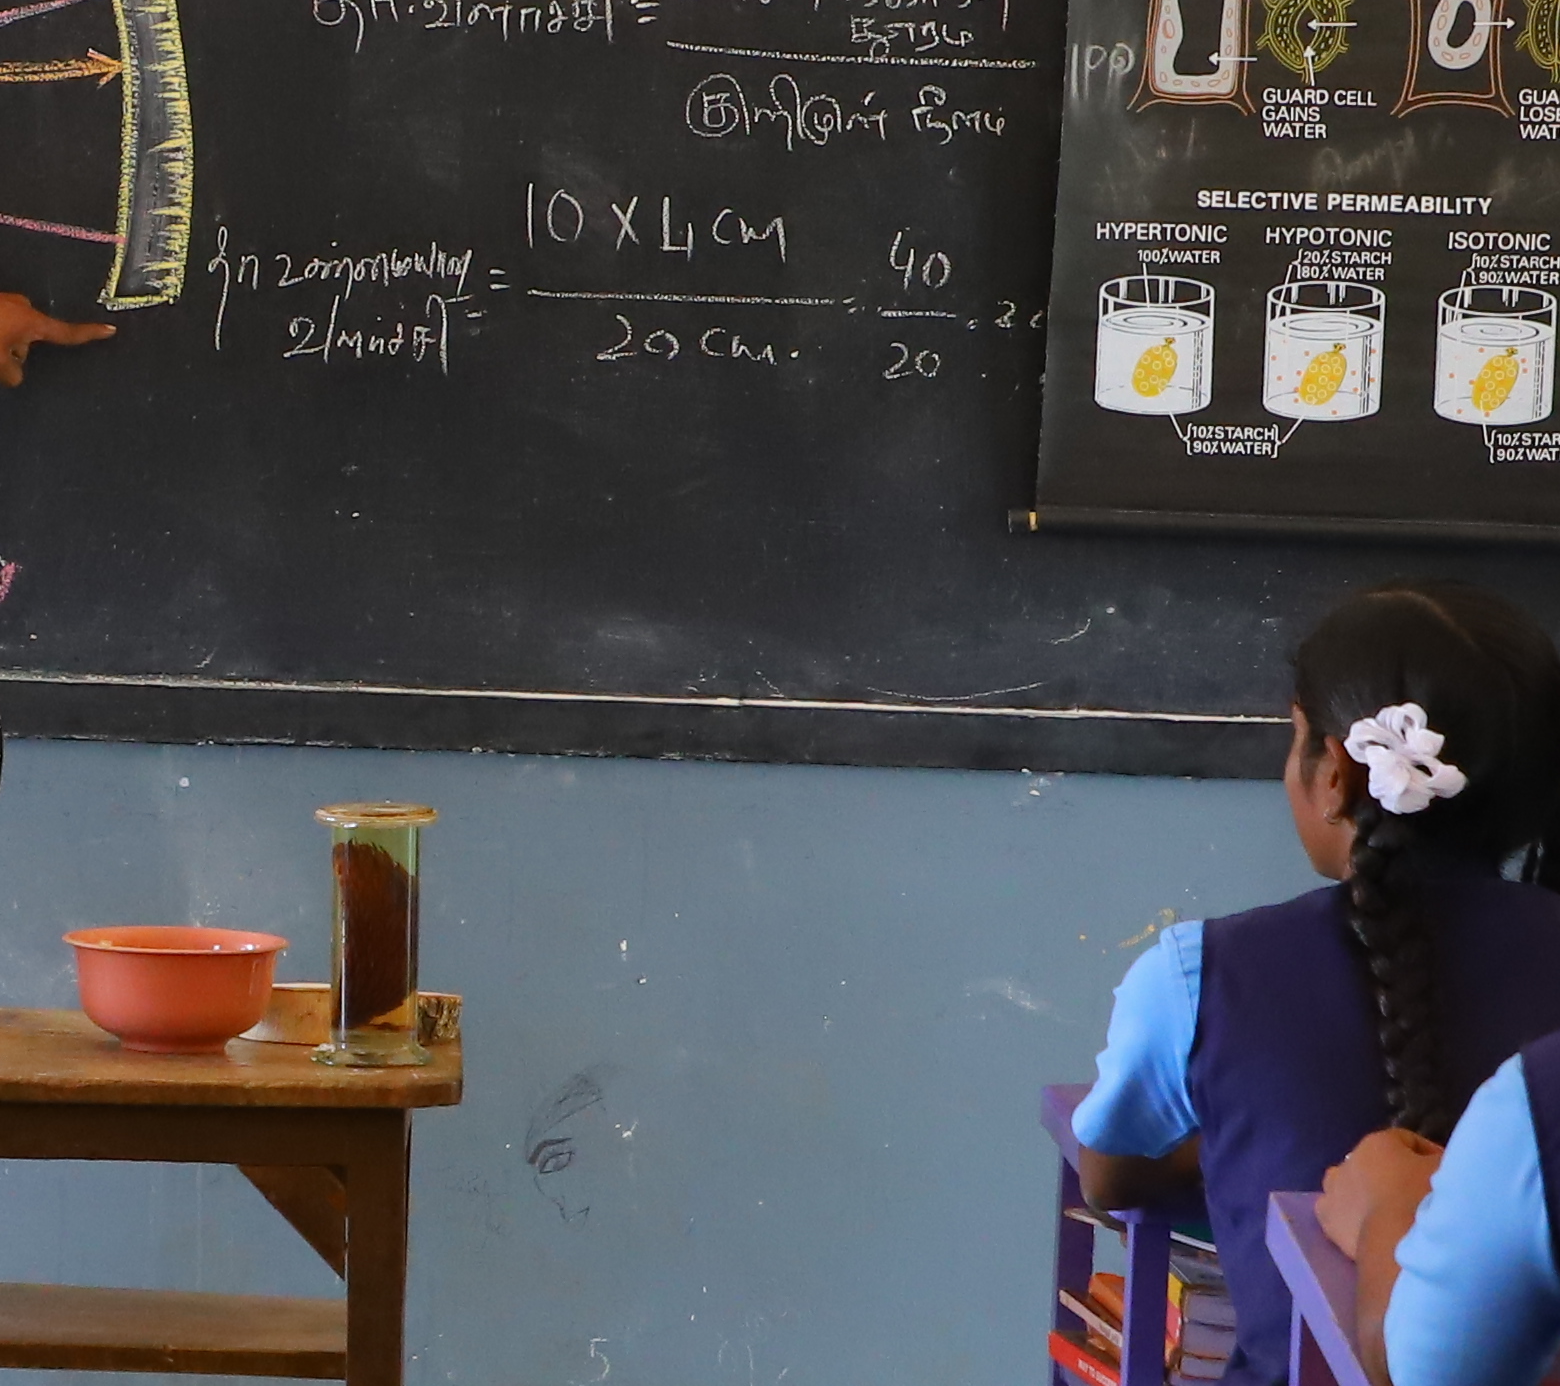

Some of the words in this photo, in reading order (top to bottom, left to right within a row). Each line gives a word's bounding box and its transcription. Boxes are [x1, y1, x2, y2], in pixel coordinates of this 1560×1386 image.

[1262, 88, 1330, 106] GUARD
[1334, 89, 1377, 107] CELL
[1262, 106, 1321, 123] GAINS
[1263, 122, 1327, 139] WATER
[1197, 190, 1319, 211] SELECTIVE
[1326, 193, 1493, 216] PERMEABILITY
[526, 182, 584, 249] 10
[1095, 222, 1228, 244] HYPERTONIC
[1265, 226, 1393, 248] HYPOTONIC
[1447, 231, 1552, 251] ISOTONIC
[889, 230, 952, 291] 40
[883, 342, 941, 380] 20
